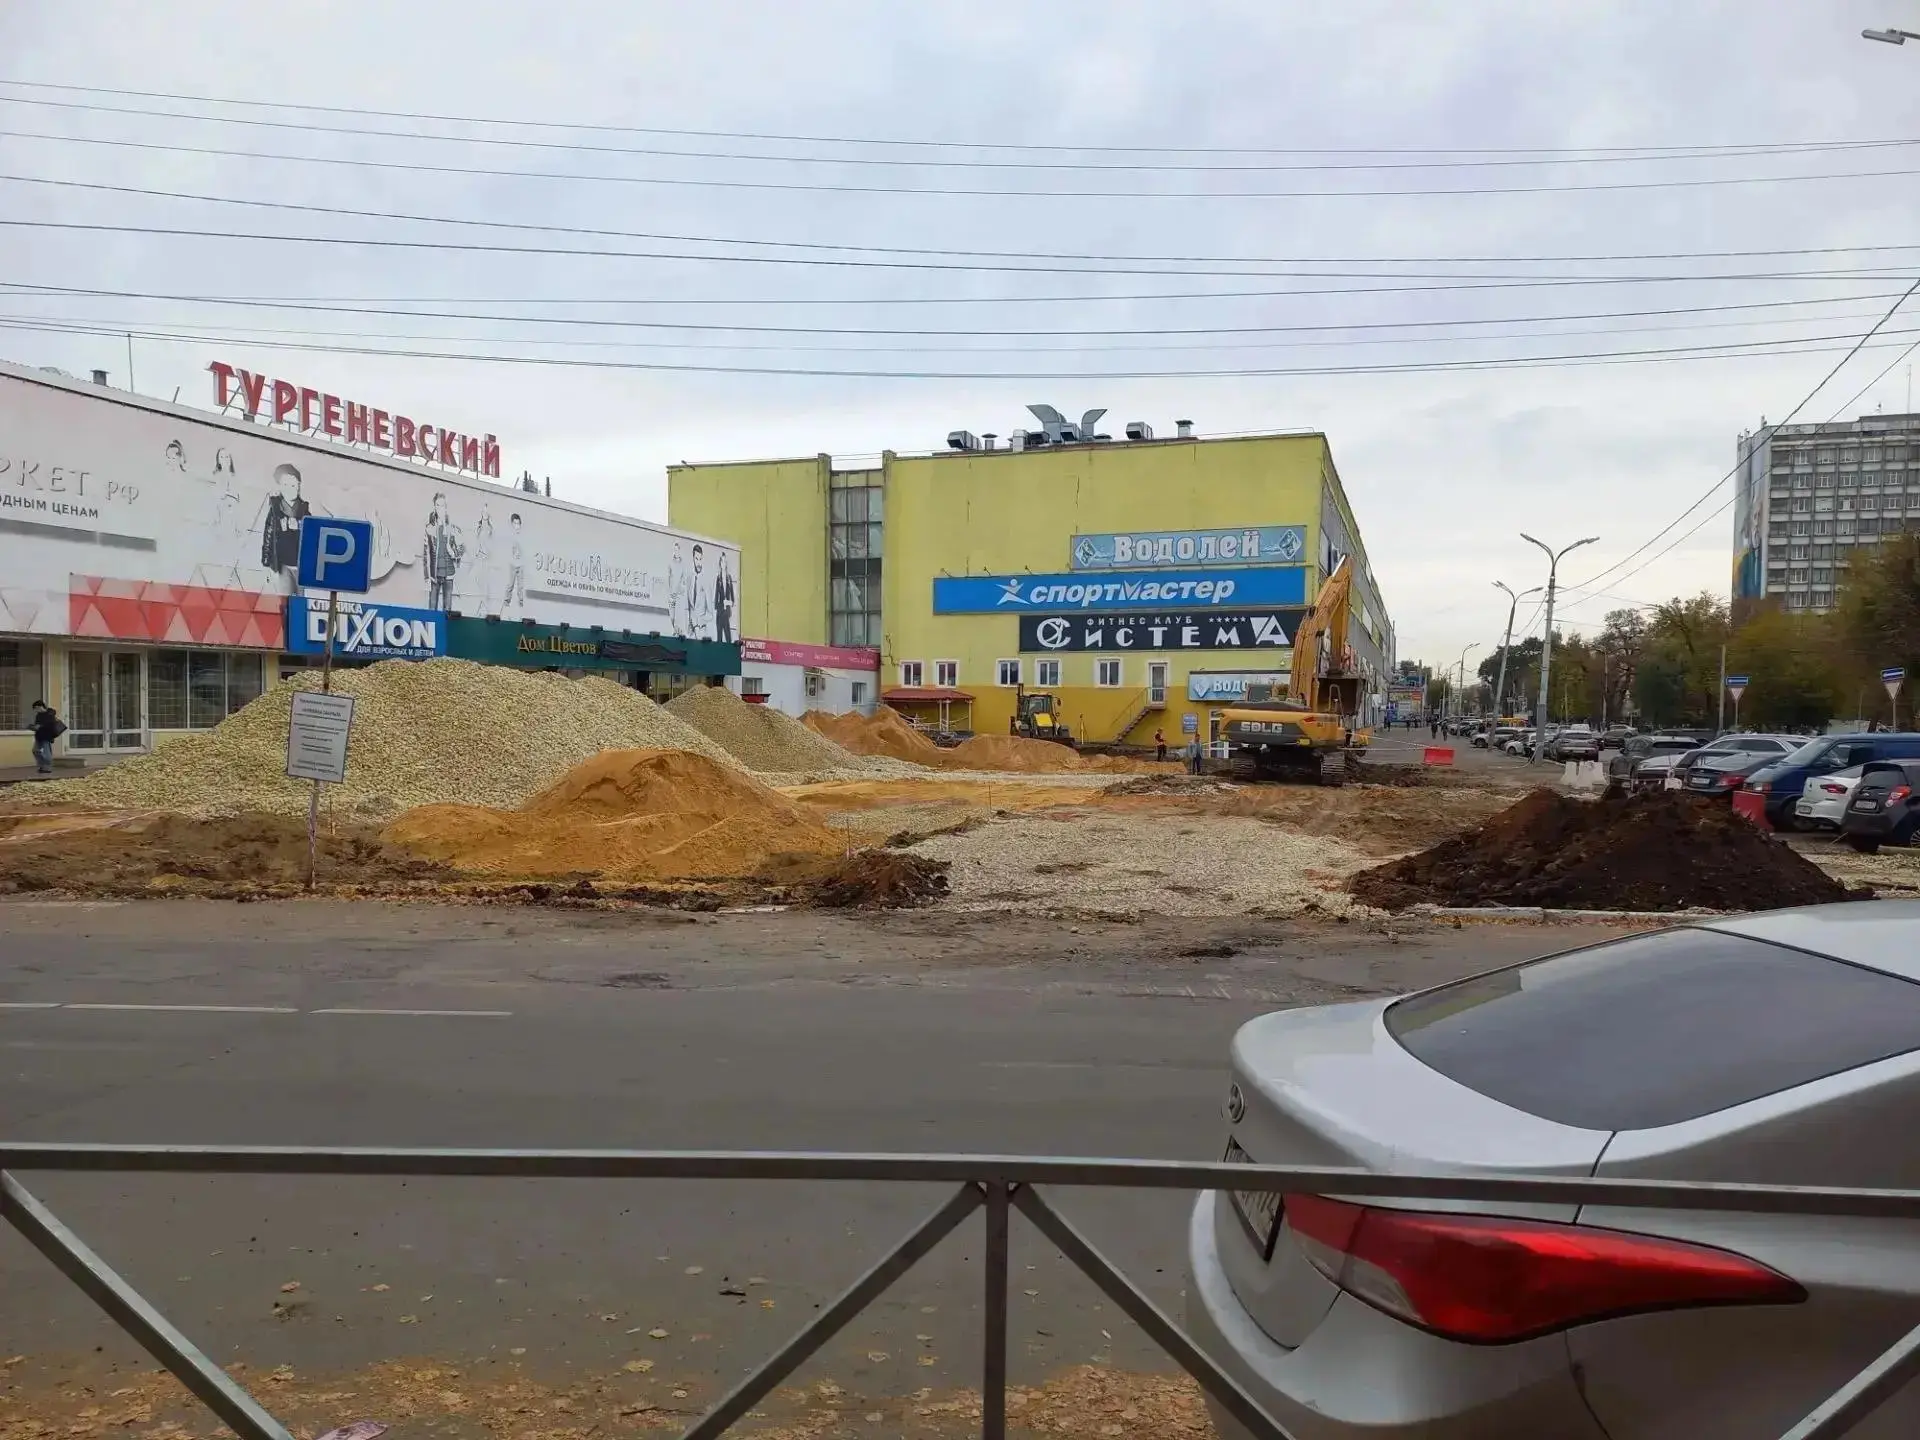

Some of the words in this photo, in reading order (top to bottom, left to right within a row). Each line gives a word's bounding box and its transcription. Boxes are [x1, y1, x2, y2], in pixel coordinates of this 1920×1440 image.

[206, 360, 500, 478] ТУРГЕНЕВСКИЙ
[0, 494, 47, 511] ДНЫМ
[52, 502, 99, 519] ЦЕНАМ
[546, 578, 572, 589] ОДЕЖДА
[578, 583, 595, 593] ОБУВЬ
[596, 585, 604, 593] ПО
[1087, 616, 1146, 626] ФИТНЕС
[1154, 615, 1193, 625] КЛУБ
[307, 609, 437, 652] DIXION
[356, 645, 371, 654] ДЛЯ
[373, 647, 407, 656] ВЗРОСЛЫХ
[517, 633, 546, 652] Дом
[550, 635, 597, 655] Цветов
[1240, 721, 1283, 734] SDLG
